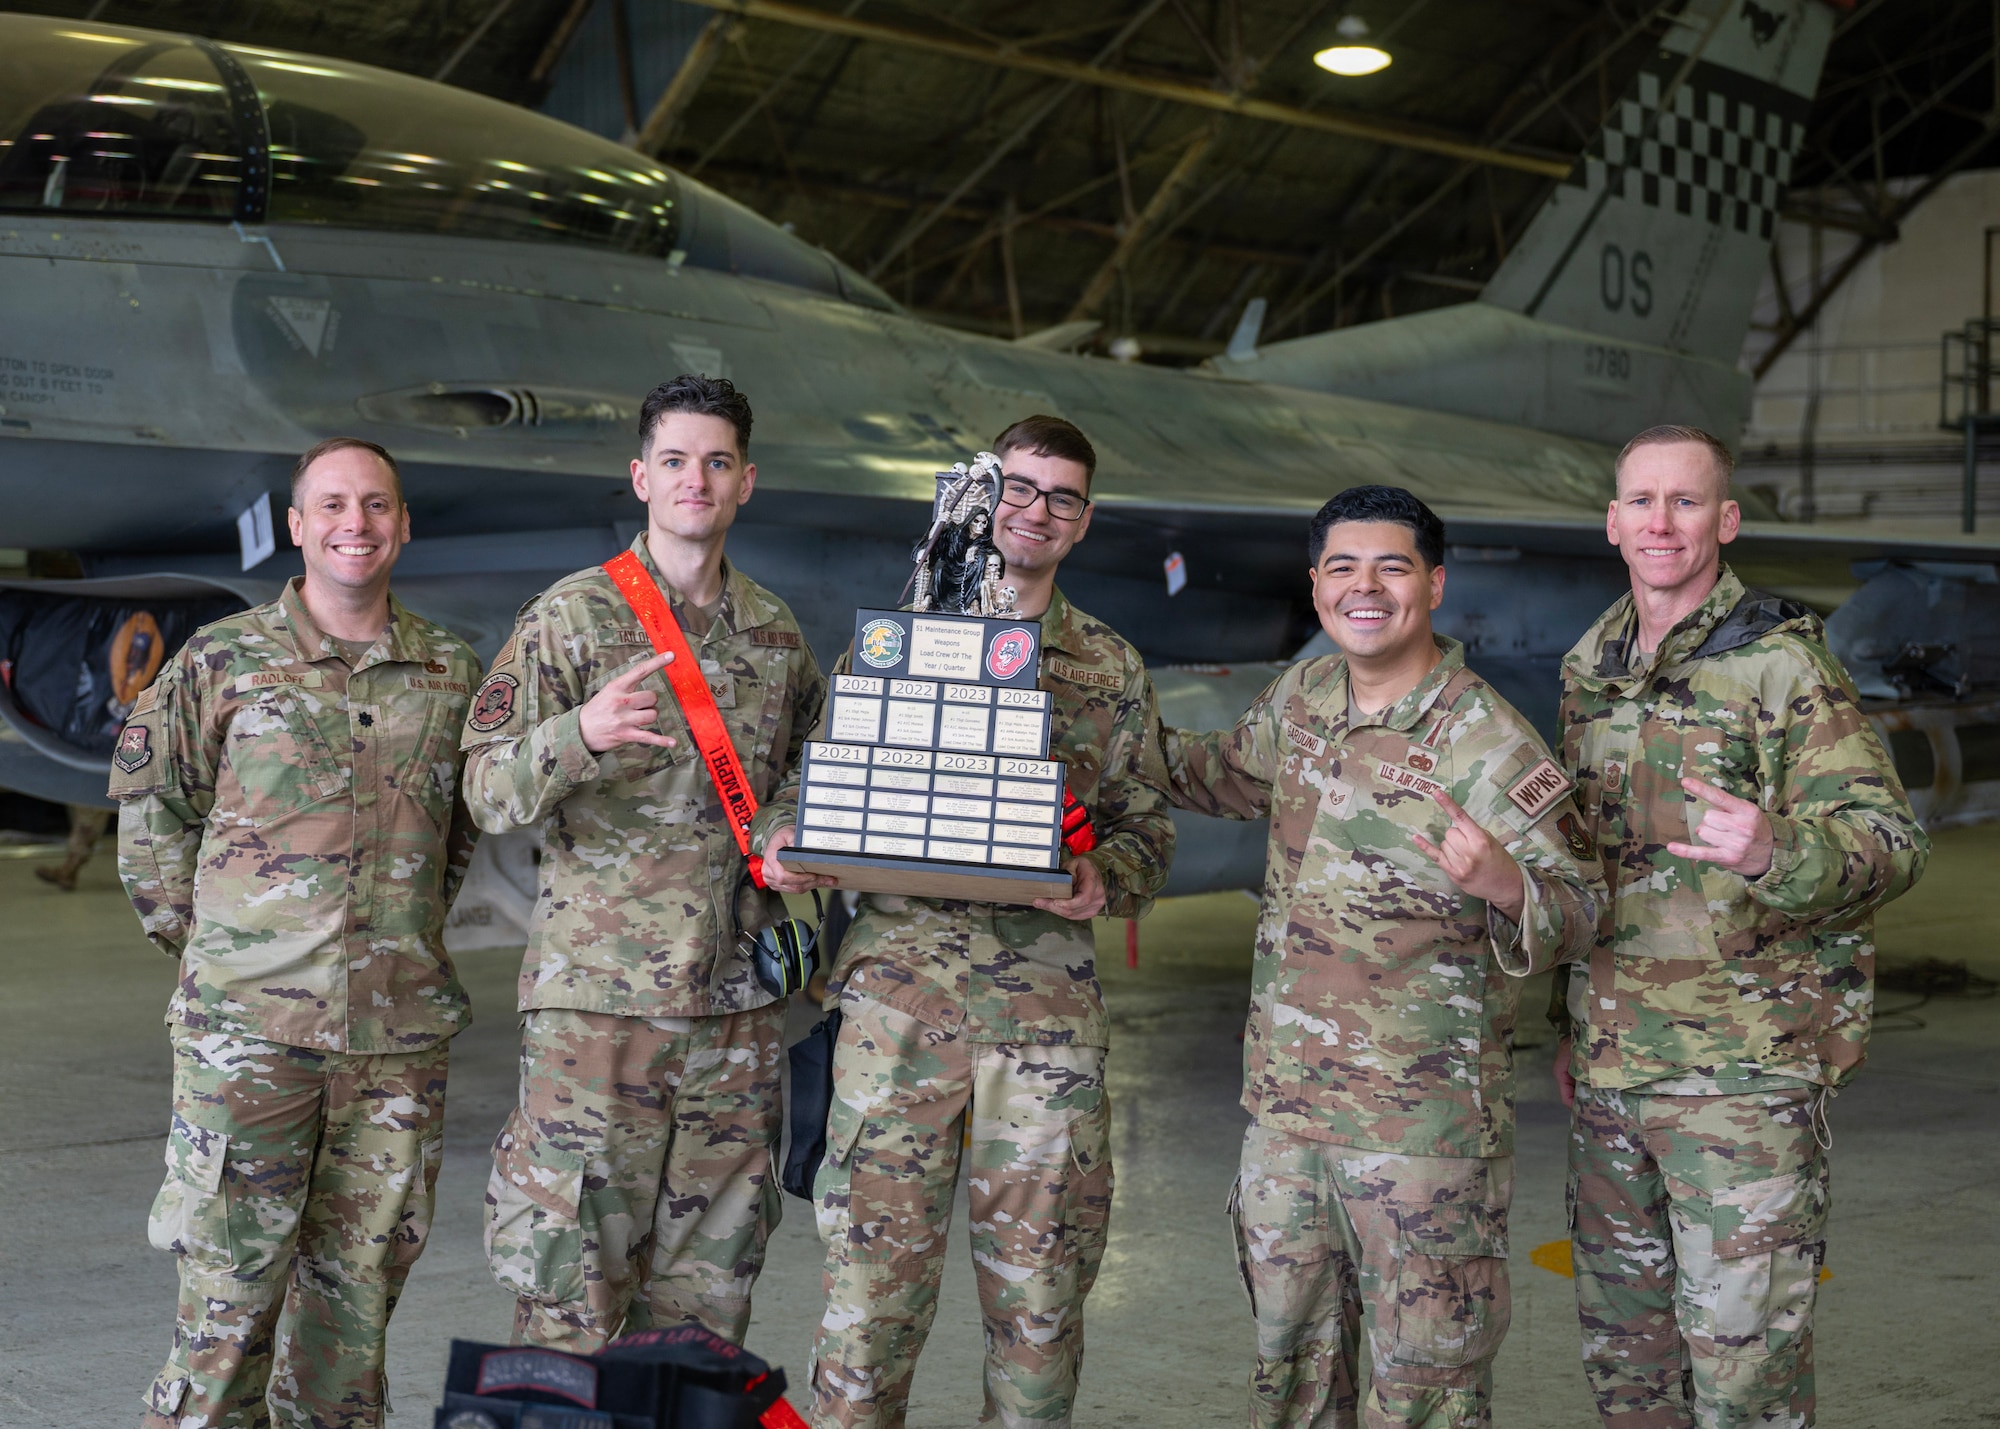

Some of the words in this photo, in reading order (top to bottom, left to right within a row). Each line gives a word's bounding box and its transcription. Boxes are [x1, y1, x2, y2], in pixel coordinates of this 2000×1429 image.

[1601, 243, 1653, 318] OS
[52, 379, 82, 393] FEET
[768, 631, 778, 644] AIR
[779, 632, 800, 646] FORCE
[925, 626, 961, 635] Maintenance
[963, 629, 980, 637] Group
[934, 639, 960, 647] Weapons
[252, 674, 305, 686] RADLOFF
[1054, 660, 1068, 678] U.S.
[1070, 670, 1085, 682] AIR
[1087, 672, 1120, 688] FORCE
[409, 677, 424, 689] U.S.
[428, 680, 442, 691] AIR
[444, 682, 468, 693] FORCE
[842, 678, 877, 691] 2021
[895, 683, 932, 696] 2022
[950, 687, 986, 700] 2023
[1003, 691, 1040, 705] 2024
[818, 746, 861, 760] 2021
[881, 751, 925, 766] 2022
[944, 756, 987, 770] 2023
[1006, 761, 1051, 775] 2024
[1380, 764, 1395, 782] U.S.
[1396, 772, 1414, 787] AIR
[1516, 767, 1562, 808] WPNS
